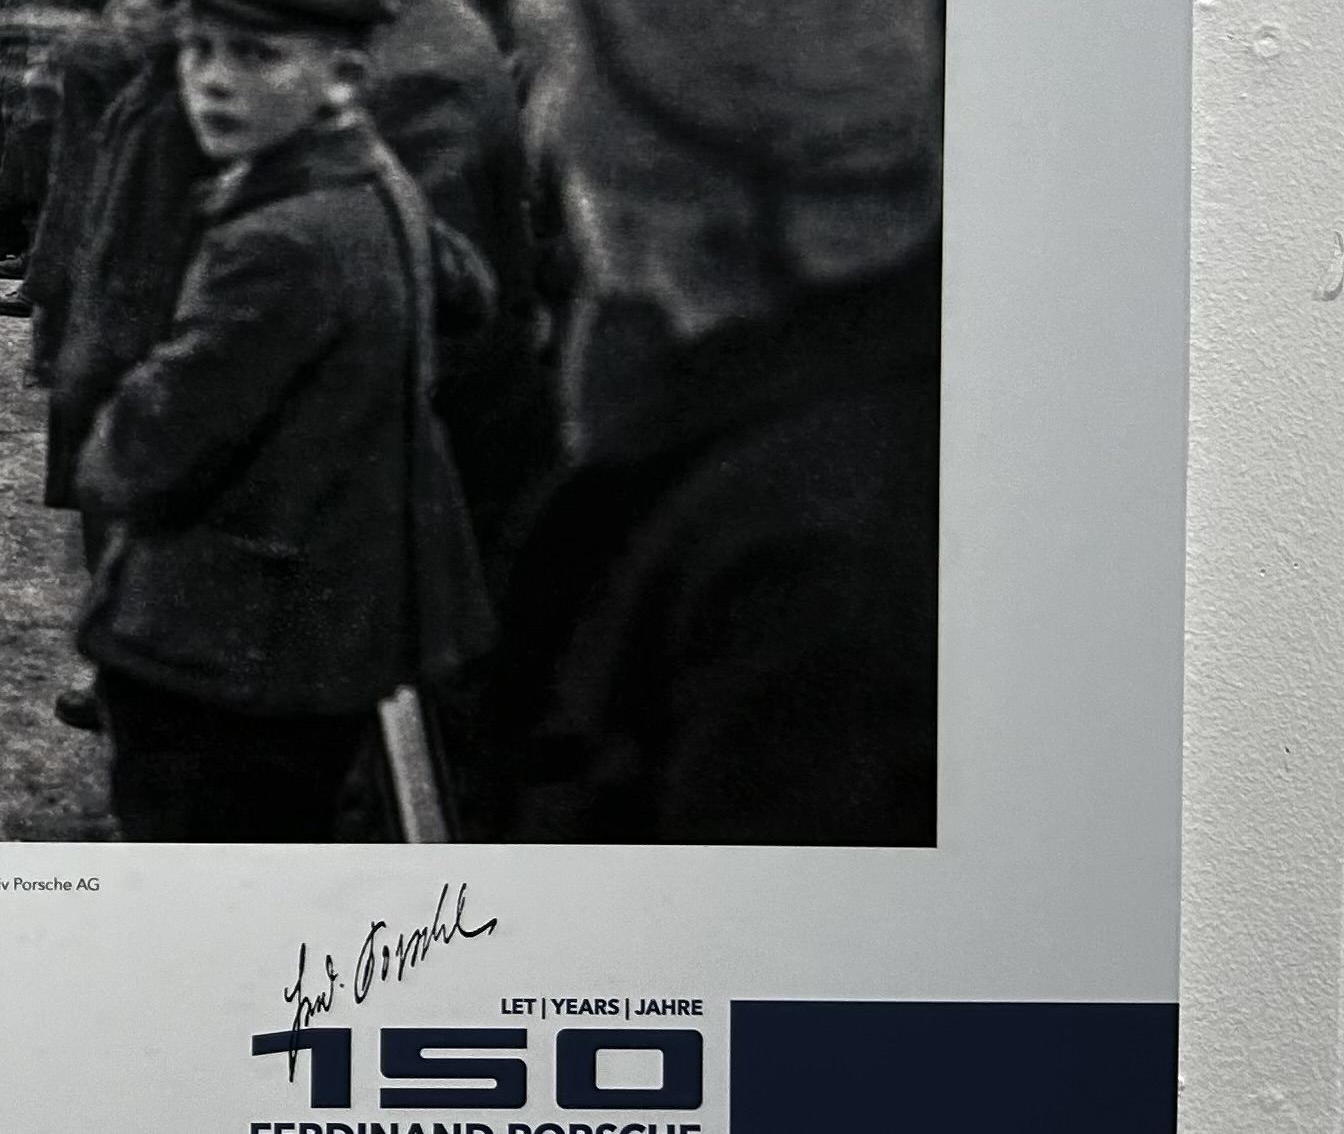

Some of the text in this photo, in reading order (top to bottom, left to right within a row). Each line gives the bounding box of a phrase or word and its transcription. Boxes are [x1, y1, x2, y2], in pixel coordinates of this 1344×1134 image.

[14, 877, 72, 892] Porsche
[76, 878, 100, 892] AG
[501, 998, 537, 1015] LET
[550, 998, 619, 1015] YEARS
[635, 998, 704, 1015] JAHRE
[252, 1028, 704, 1110] 150
